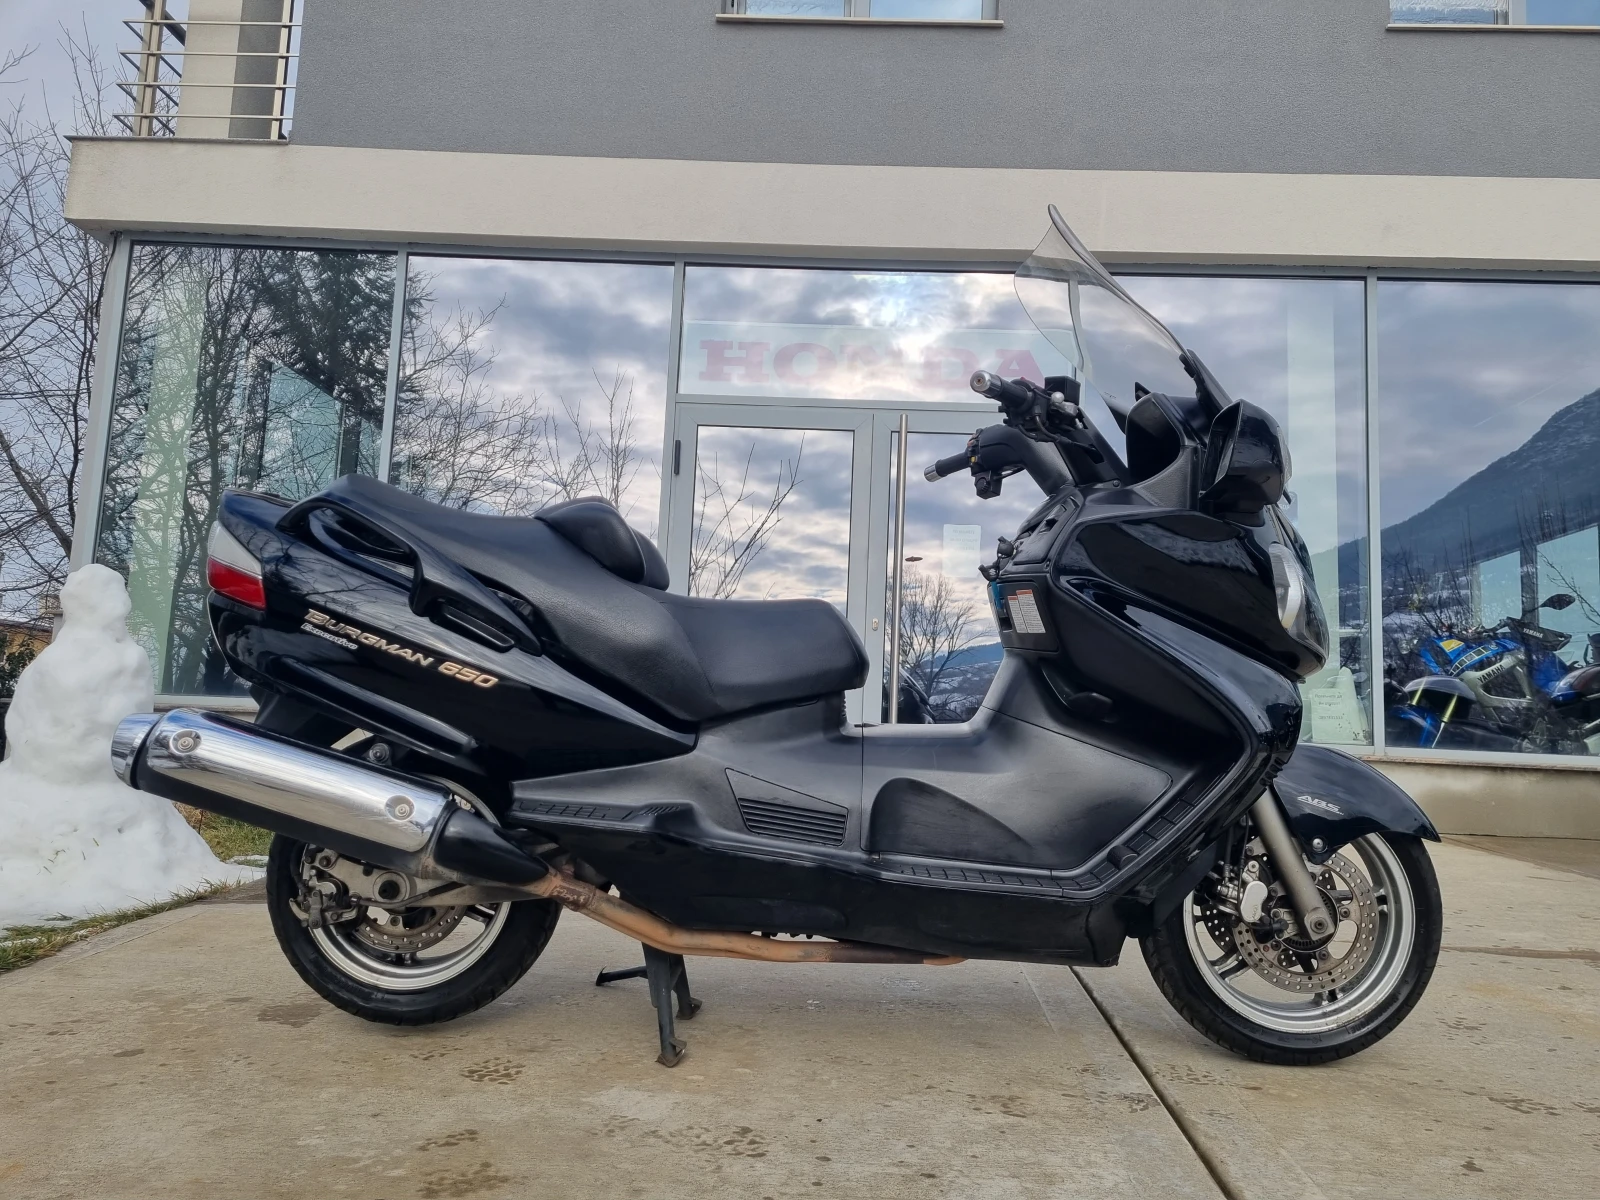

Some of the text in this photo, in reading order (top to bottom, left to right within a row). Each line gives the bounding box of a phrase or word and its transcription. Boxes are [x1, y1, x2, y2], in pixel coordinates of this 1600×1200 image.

[699, 339, 1046, 389] HONDA
[300, 622, 358, 650] Executive
[1522, 627, 1544, 639] YAMAHA
[303, 608, 499, 688] BURGMAN 650
[1477, 664, 1506, 684] YAMAHA
[1297, 795, 1341, 812] ABS
